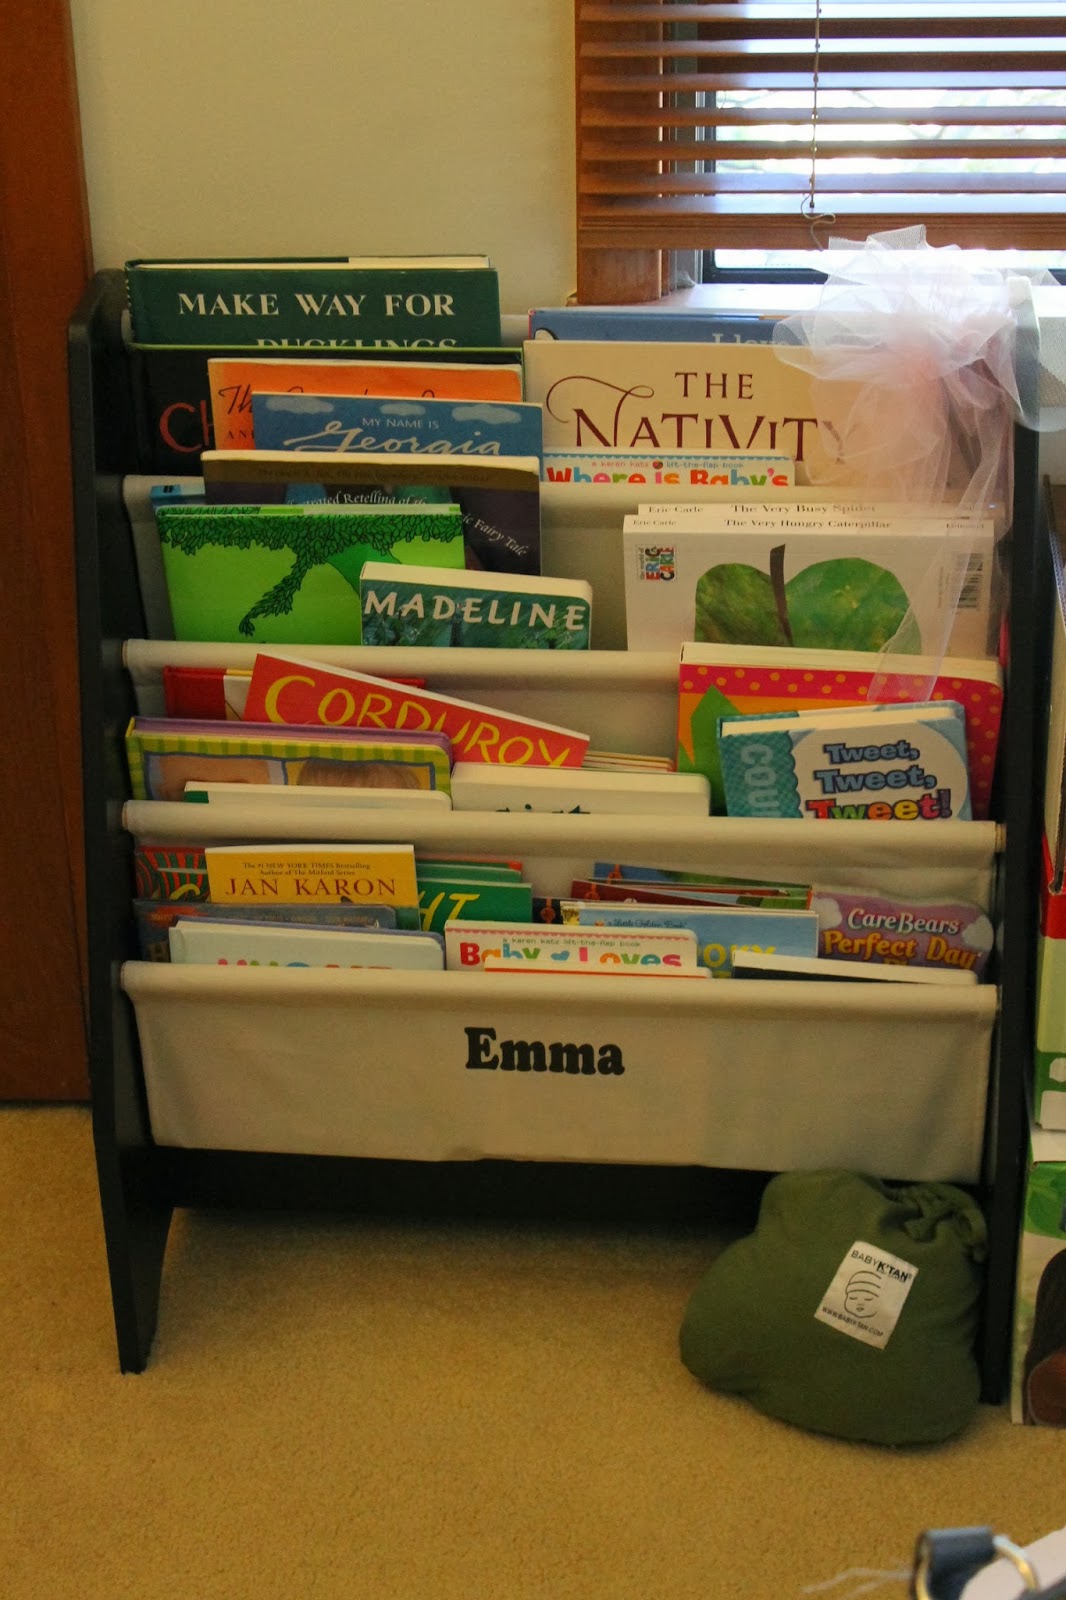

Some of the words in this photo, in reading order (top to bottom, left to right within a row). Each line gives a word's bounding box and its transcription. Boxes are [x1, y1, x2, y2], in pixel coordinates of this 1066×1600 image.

[178, 293, 279, 316] MAKE
[294, 293, 367, 316] WAY
[385, 294, 456, 317] FOR
[674, 371, 754, 400] THE
[362, 417, 381, 428] MY
[386, 418, 423, 429] NAME
[428, 419, 439, 430] IS
[648, 505, 671, 513] Eric
[674, 505, 703, 513] Carle
[731, 504, 757, 513] The
[762, 504, 790, 514] Very
[796, 504, 828, 514] Busy
[833, 504, 876, 514] Spider
[474, 519, 504, 542] Fairy
[505, 536, 529, 556] Tale
[724, 519, 746, 527] The
[751, 519, 776, 528] Very
[781, 520, 824, 529] Hungry
[828, 520, 892, 529] Caterpillar
[363, 589, 587, 631] MADELINE
[823, 740, 920, 765] Tweet,
[813, 764, 937, 794] Tweet,
[806, 788, 952, 820] Tweet!
[226, 878, 278, 896] JAN
[295, 878, 396, 897] KARON
[823, 930, 917, 960] Perfect
[926, 936, 977, 970] Day
[464, 1026, 625, 1077] Emma
